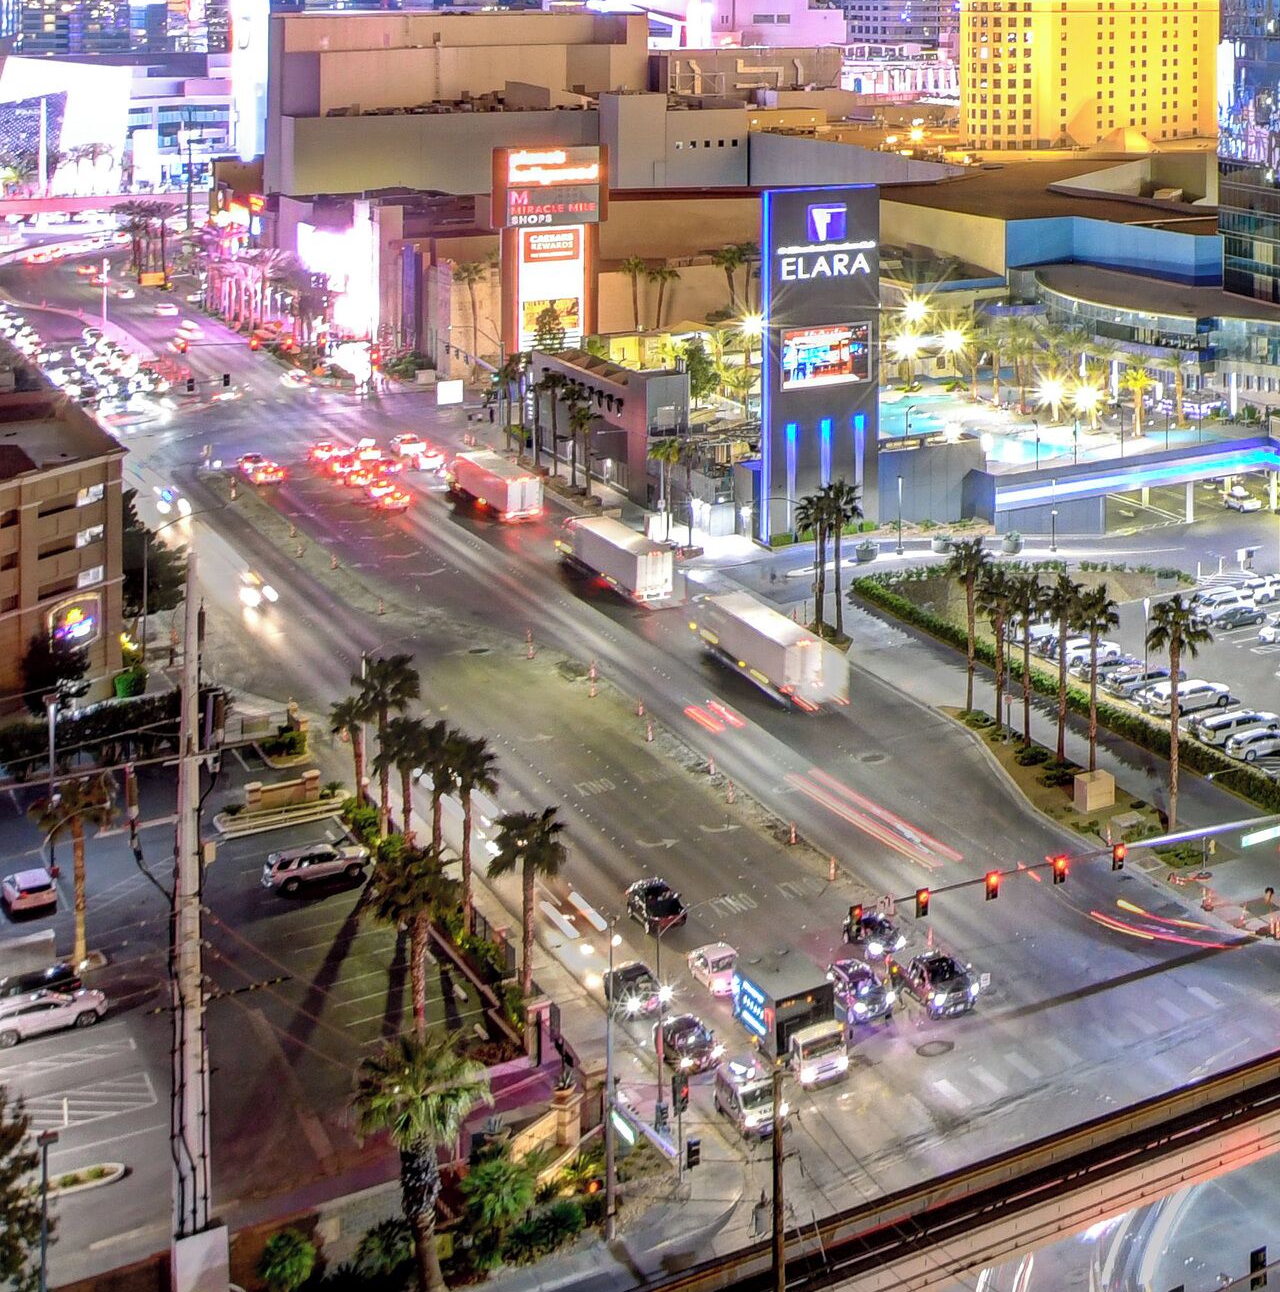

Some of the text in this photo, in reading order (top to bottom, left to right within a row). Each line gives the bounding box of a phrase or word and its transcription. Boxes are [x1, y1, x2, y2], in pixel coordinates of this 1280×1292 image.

[511, 202, 597, 216] MIRACLE MILE
[511, 214, 553, 225] SHOPS
[530, 240, 574, 251] REWARDS
[781, 253, 871, 281] ELARA
